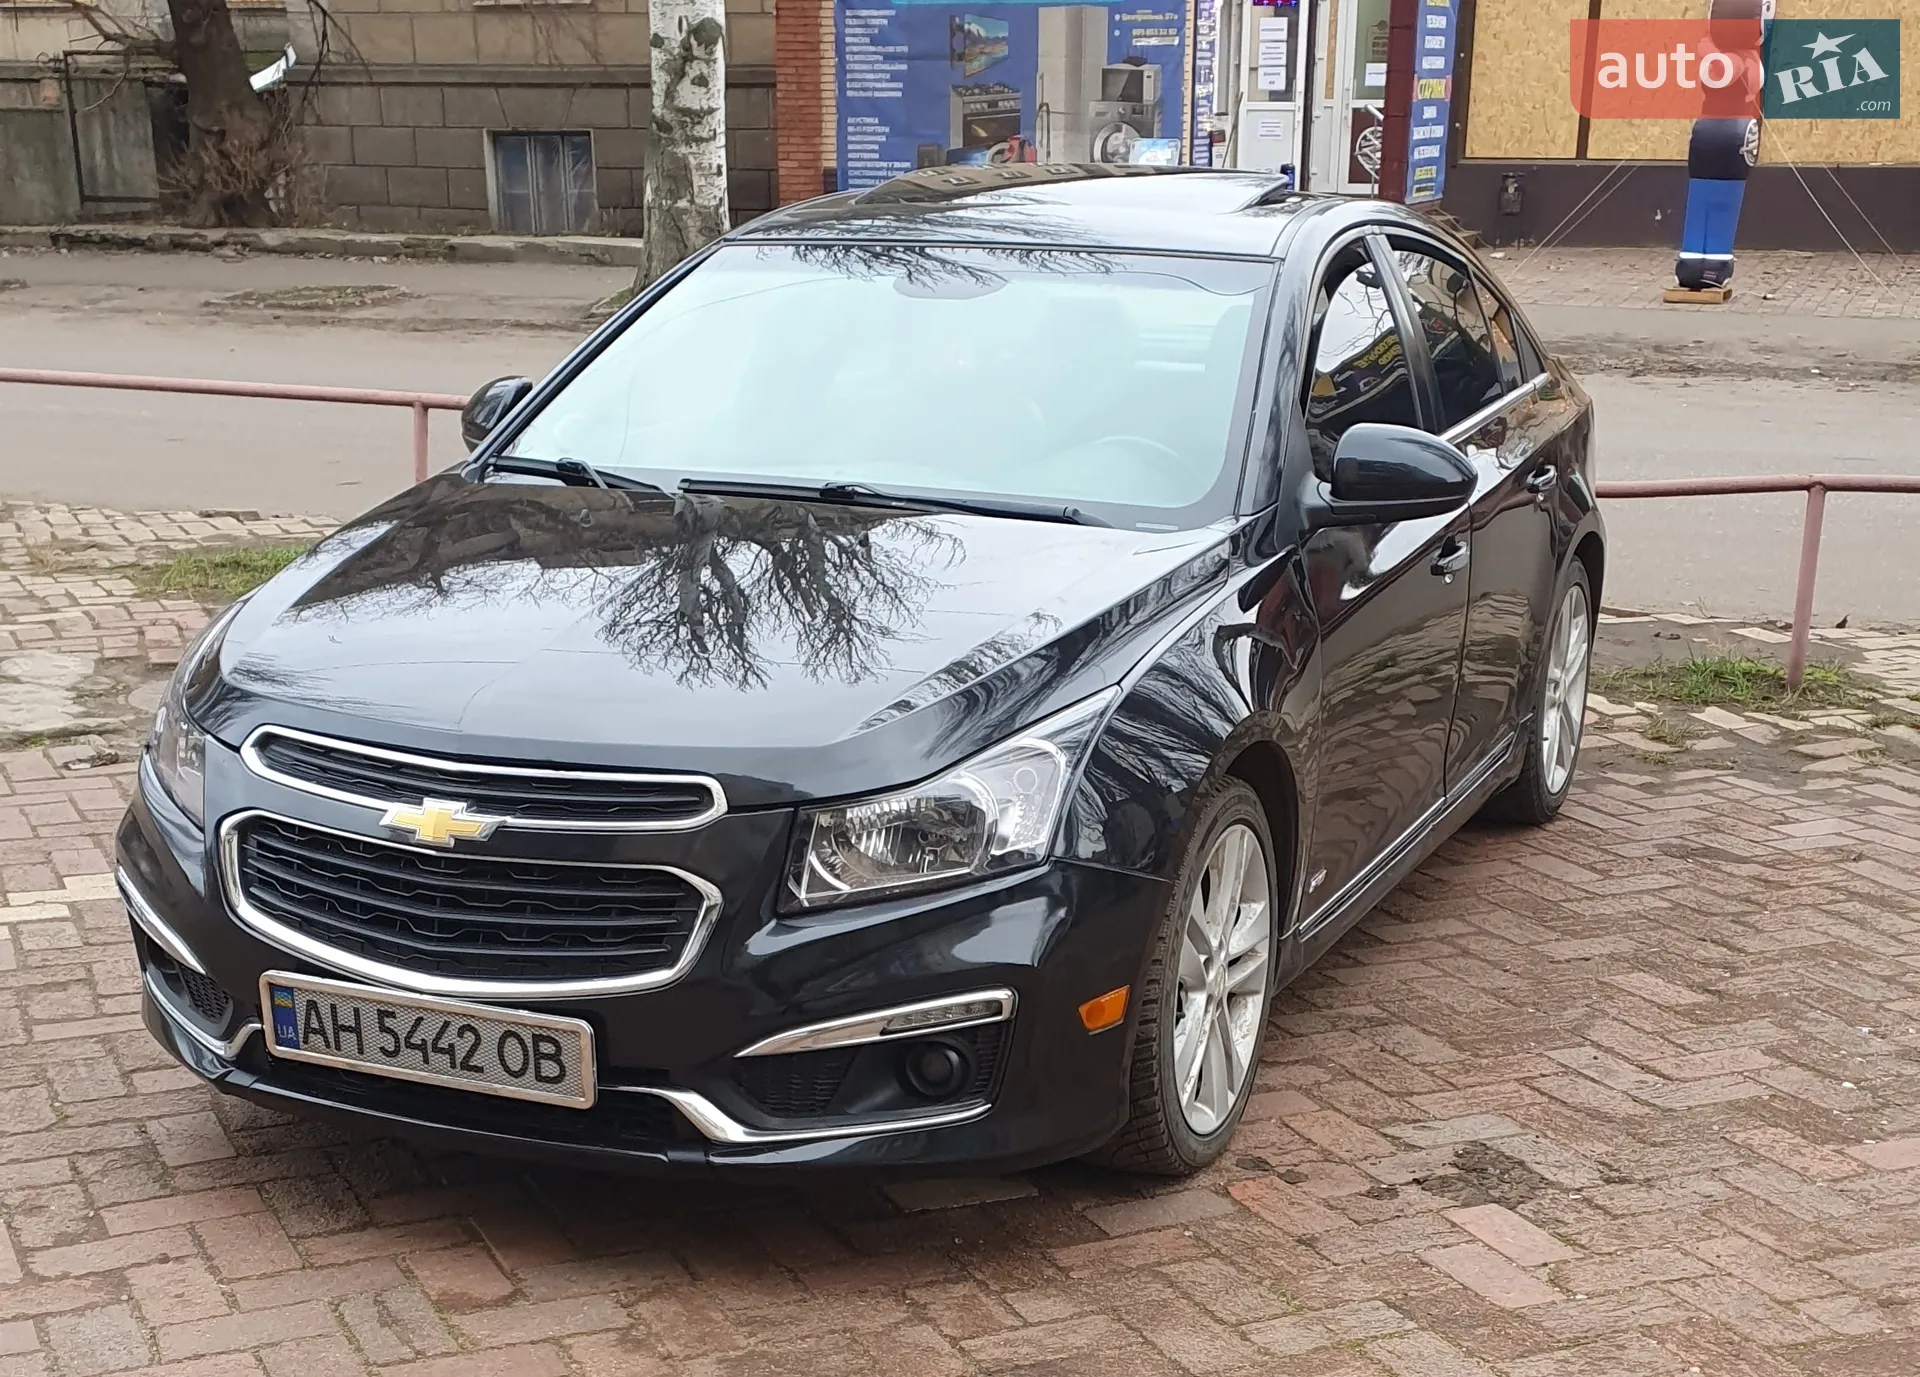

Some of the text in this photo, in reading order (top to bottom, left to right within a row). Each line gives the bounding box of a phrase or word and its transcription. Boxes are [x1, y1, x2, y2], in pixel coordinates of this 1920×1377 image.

[277, 1023, 297, 1042] UA
[302, 999, 567, 1085] AH 5442 OB
